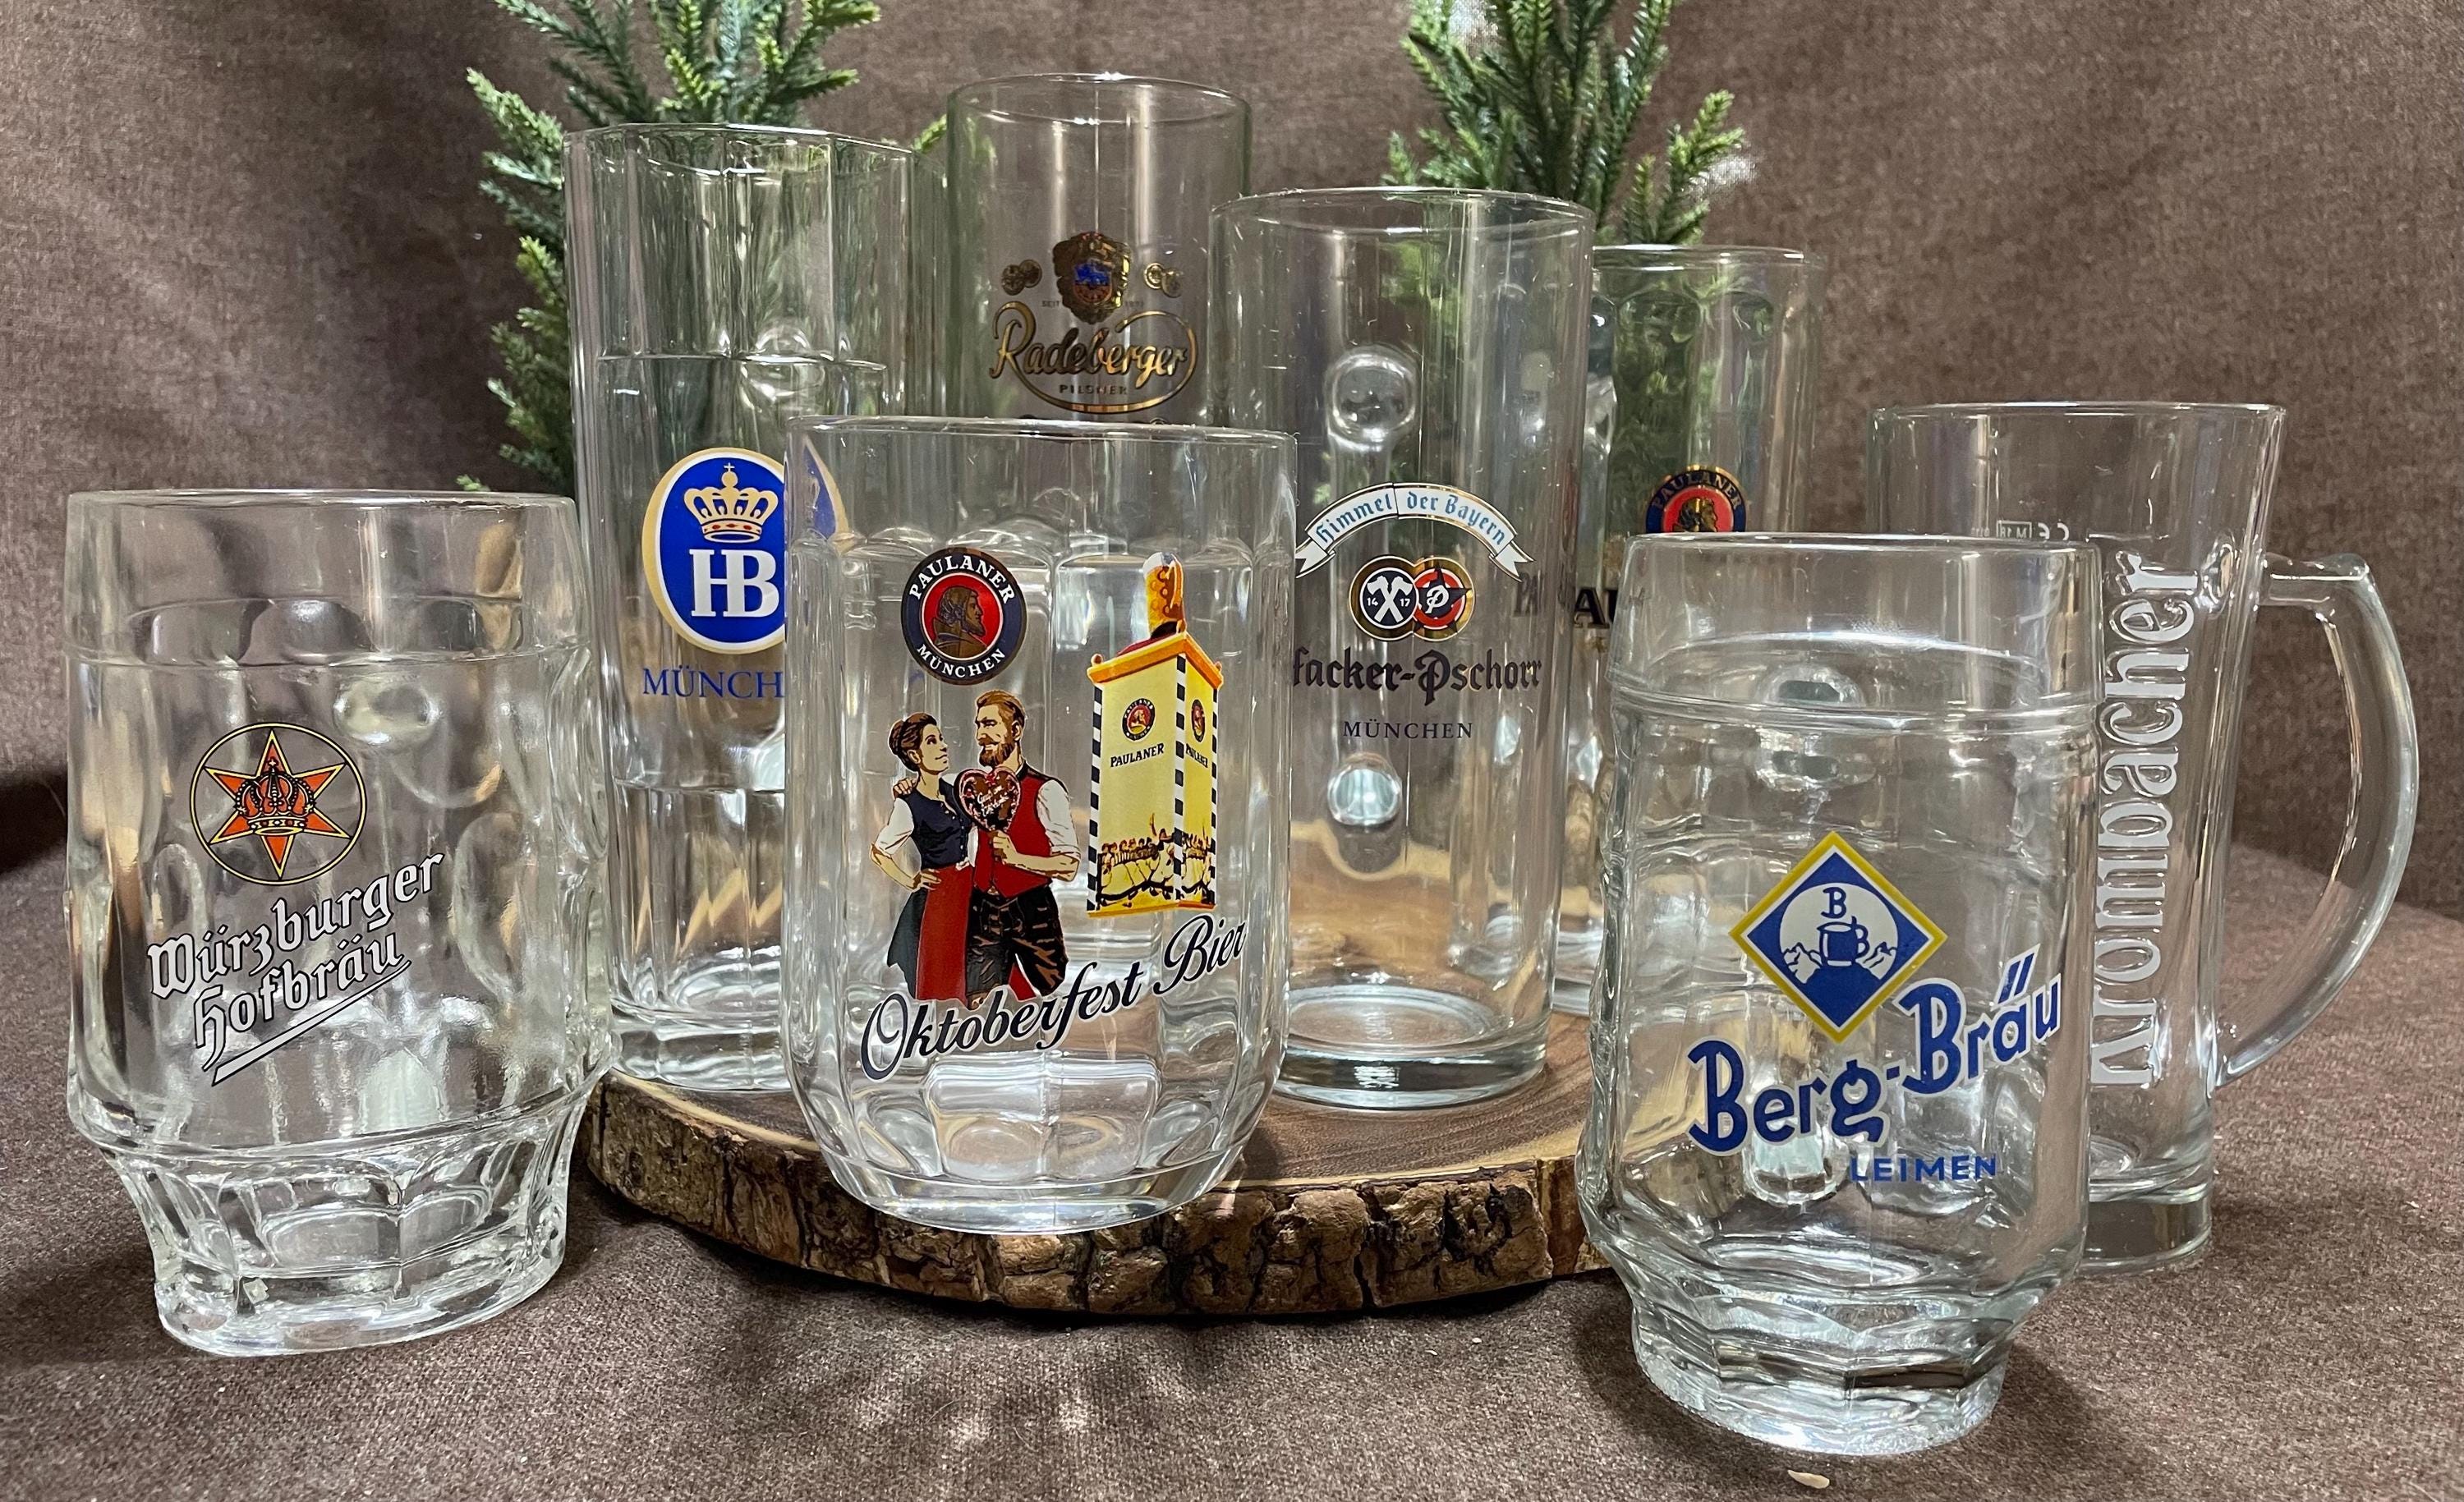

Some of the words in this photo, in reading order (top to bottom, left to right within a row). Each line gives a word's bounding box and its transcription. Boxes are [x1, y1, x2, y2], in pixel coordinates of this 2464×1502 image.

[990, 301, 1188, 389] Radeberger
[1059, 384, 1128, 395] PILSNER
[1651, 471, 1742, 510] PAULANER
[1315, 493, 1394, 544] Himmel
[1406, 491, 1440, 511] der
[1444, 494, 1506, 546] Bayern
[688, 549, 780, 618] HB
[908, 554, 1016, 604] PAULANER
[1366, 597, 1379, 607] 14
[1400, 597, 1411, 608] 17
[642, 664, 785, 699] MÜNCH
[916, 643, 1006, 678] MÜNCHEN
[1343, 719, 1473, 739] MÜNCHEN
[1110, 742, 1165, 768] PAULANER
[146, 852, 445, 999] Würzburger
[193, 933, 406, 1072] Hofbräu
[860, 961, 1145, 1082] Oktoberfest
[1152, 914, 1247, 996] Bier
[1687, 949, 2062, 1154] Berg-Bräu
[1850, 1154, 1997, 1183] LEIMEN
